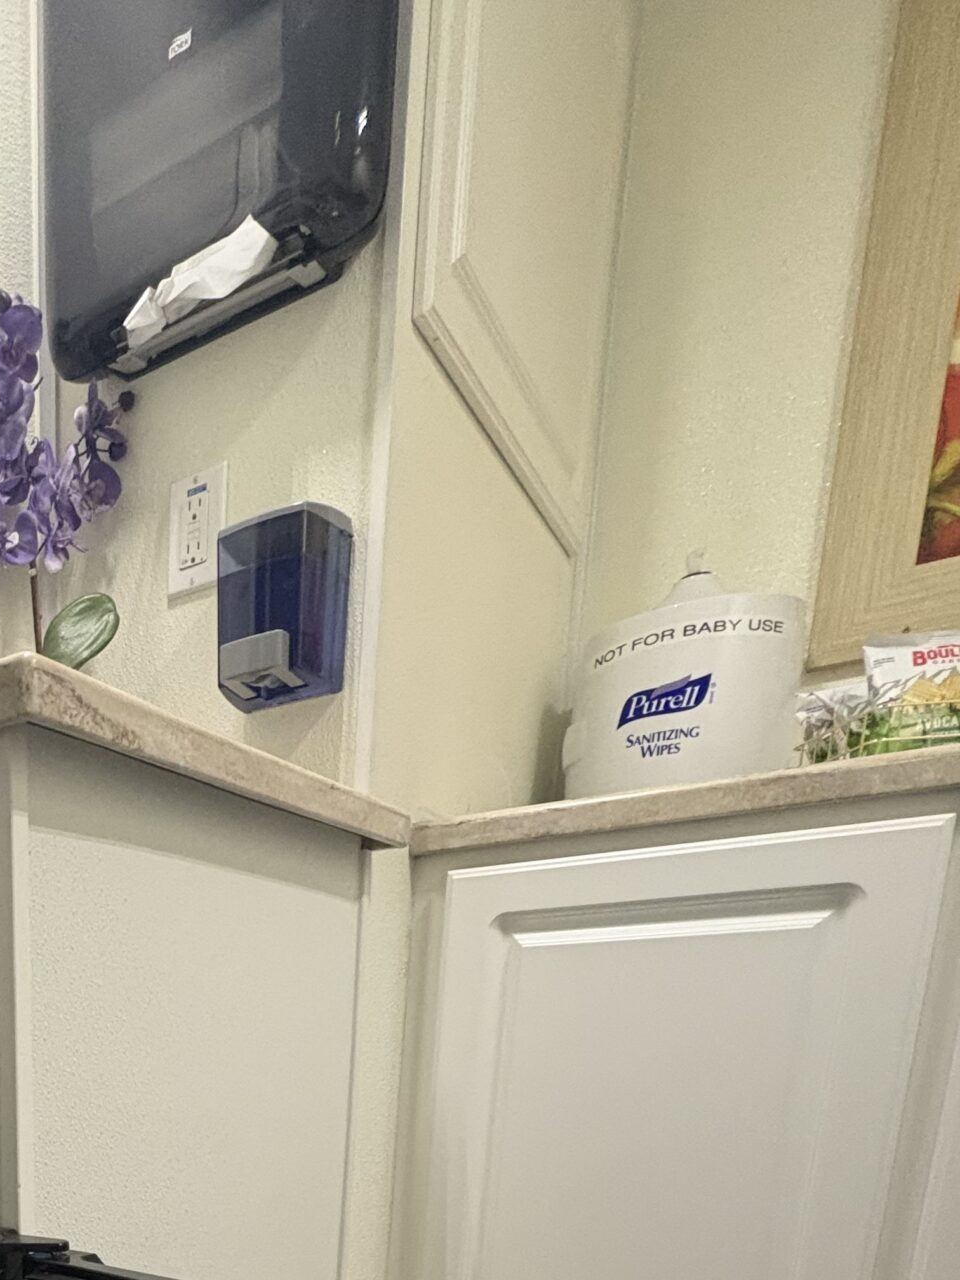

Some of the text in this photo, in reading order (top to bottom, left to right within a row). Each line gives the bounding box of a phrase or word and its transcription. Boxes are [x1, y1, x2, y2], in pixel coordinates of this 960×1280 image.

[593, 618, 785, 670] NOT FOR BABY USE
[912, 648, 960, 667] BOUL
[626, 685, 701, 720] Purell
[625, 726, 701, 749] SANITIZING
[640, 743, 681, 759] WIPES
